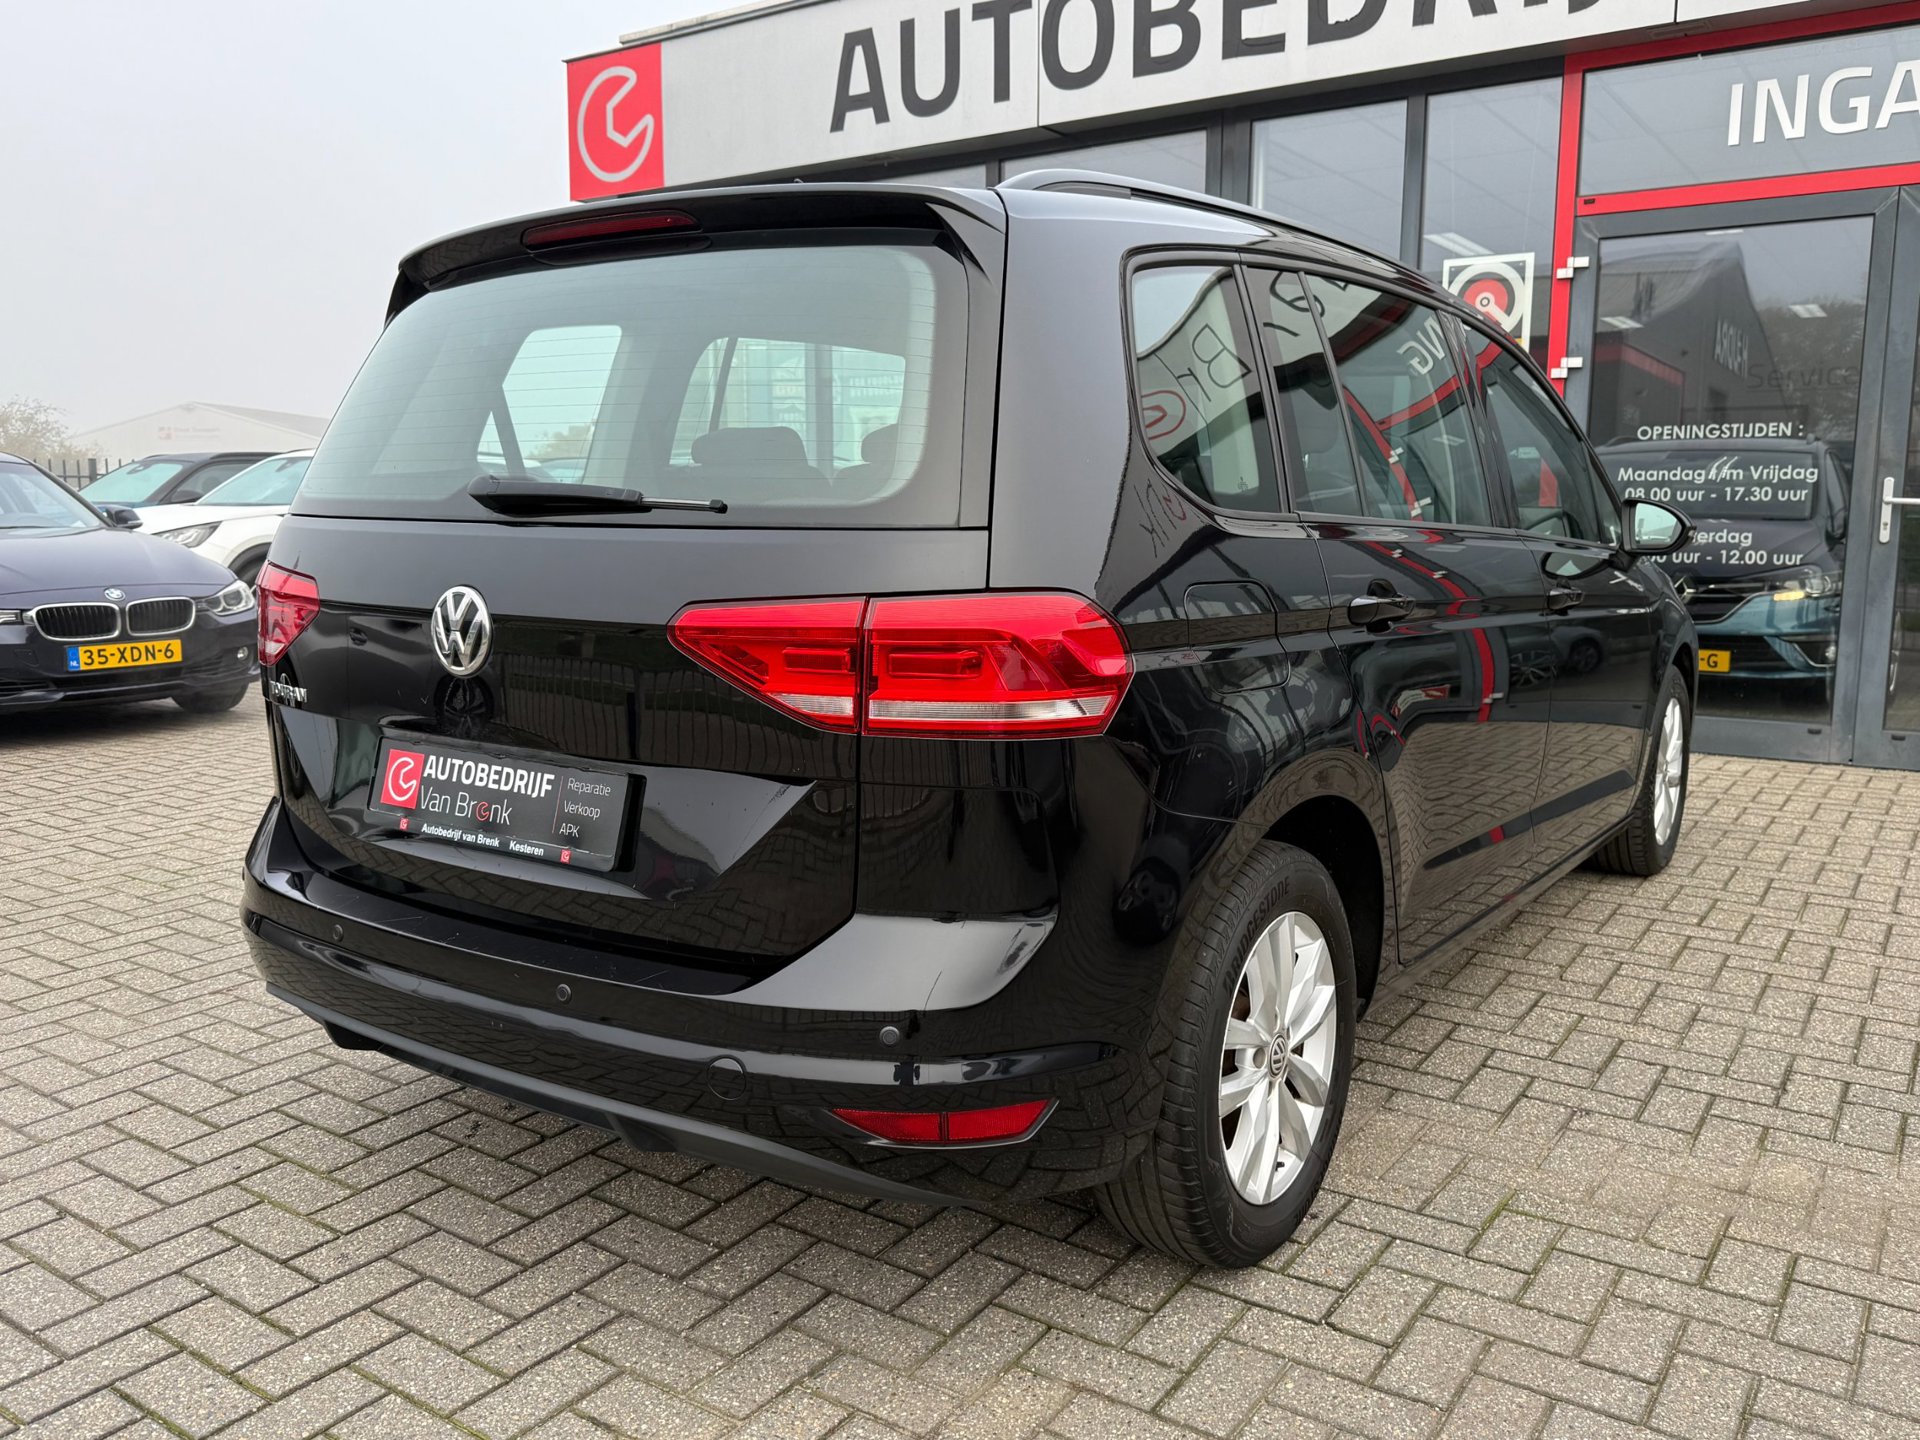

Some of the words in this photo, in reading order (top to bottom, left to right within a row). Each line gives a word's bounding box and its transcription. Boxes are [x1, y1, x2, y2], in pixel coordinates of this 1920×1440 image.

[830, 0, 1602, 133] AUTOBE
[1637, 422, 1792, 440] OPENINGSTIJDEN
[1617, 466, 1705, 484] Maandag
[1750, 464, 1819, 483] Vrijdag
[1625, 487, 1671, 501] 0800
[1676, 489, 1705, 501] uur
[1724, 486, 1772, 501] 17.30
[1777, 488, 1808, 501] uur
[1692, 529, 1752, 546] erdag
[1672, 552, 1701, 563] uur
[1720, 550, 1767, 564] 12.00
[1773, 552, 1803, 565] uur
[83, 643, 174, 667] 35-XDN-6
[423, 755, 555, 798] AUTOBEDRIJF
[567, 777, 611, 797] Reparatie
[420, 785, 451, 814] Van
[564, 800, 600, 819] Verkoop
[421, 823, 462, 842] Autobedrijf
[463, 832, 476, 843] van
[477, 834, 499, 848] Brenk
[509, 840, 544, 856] Kesteren
[559, 822, 580, 838] APK
